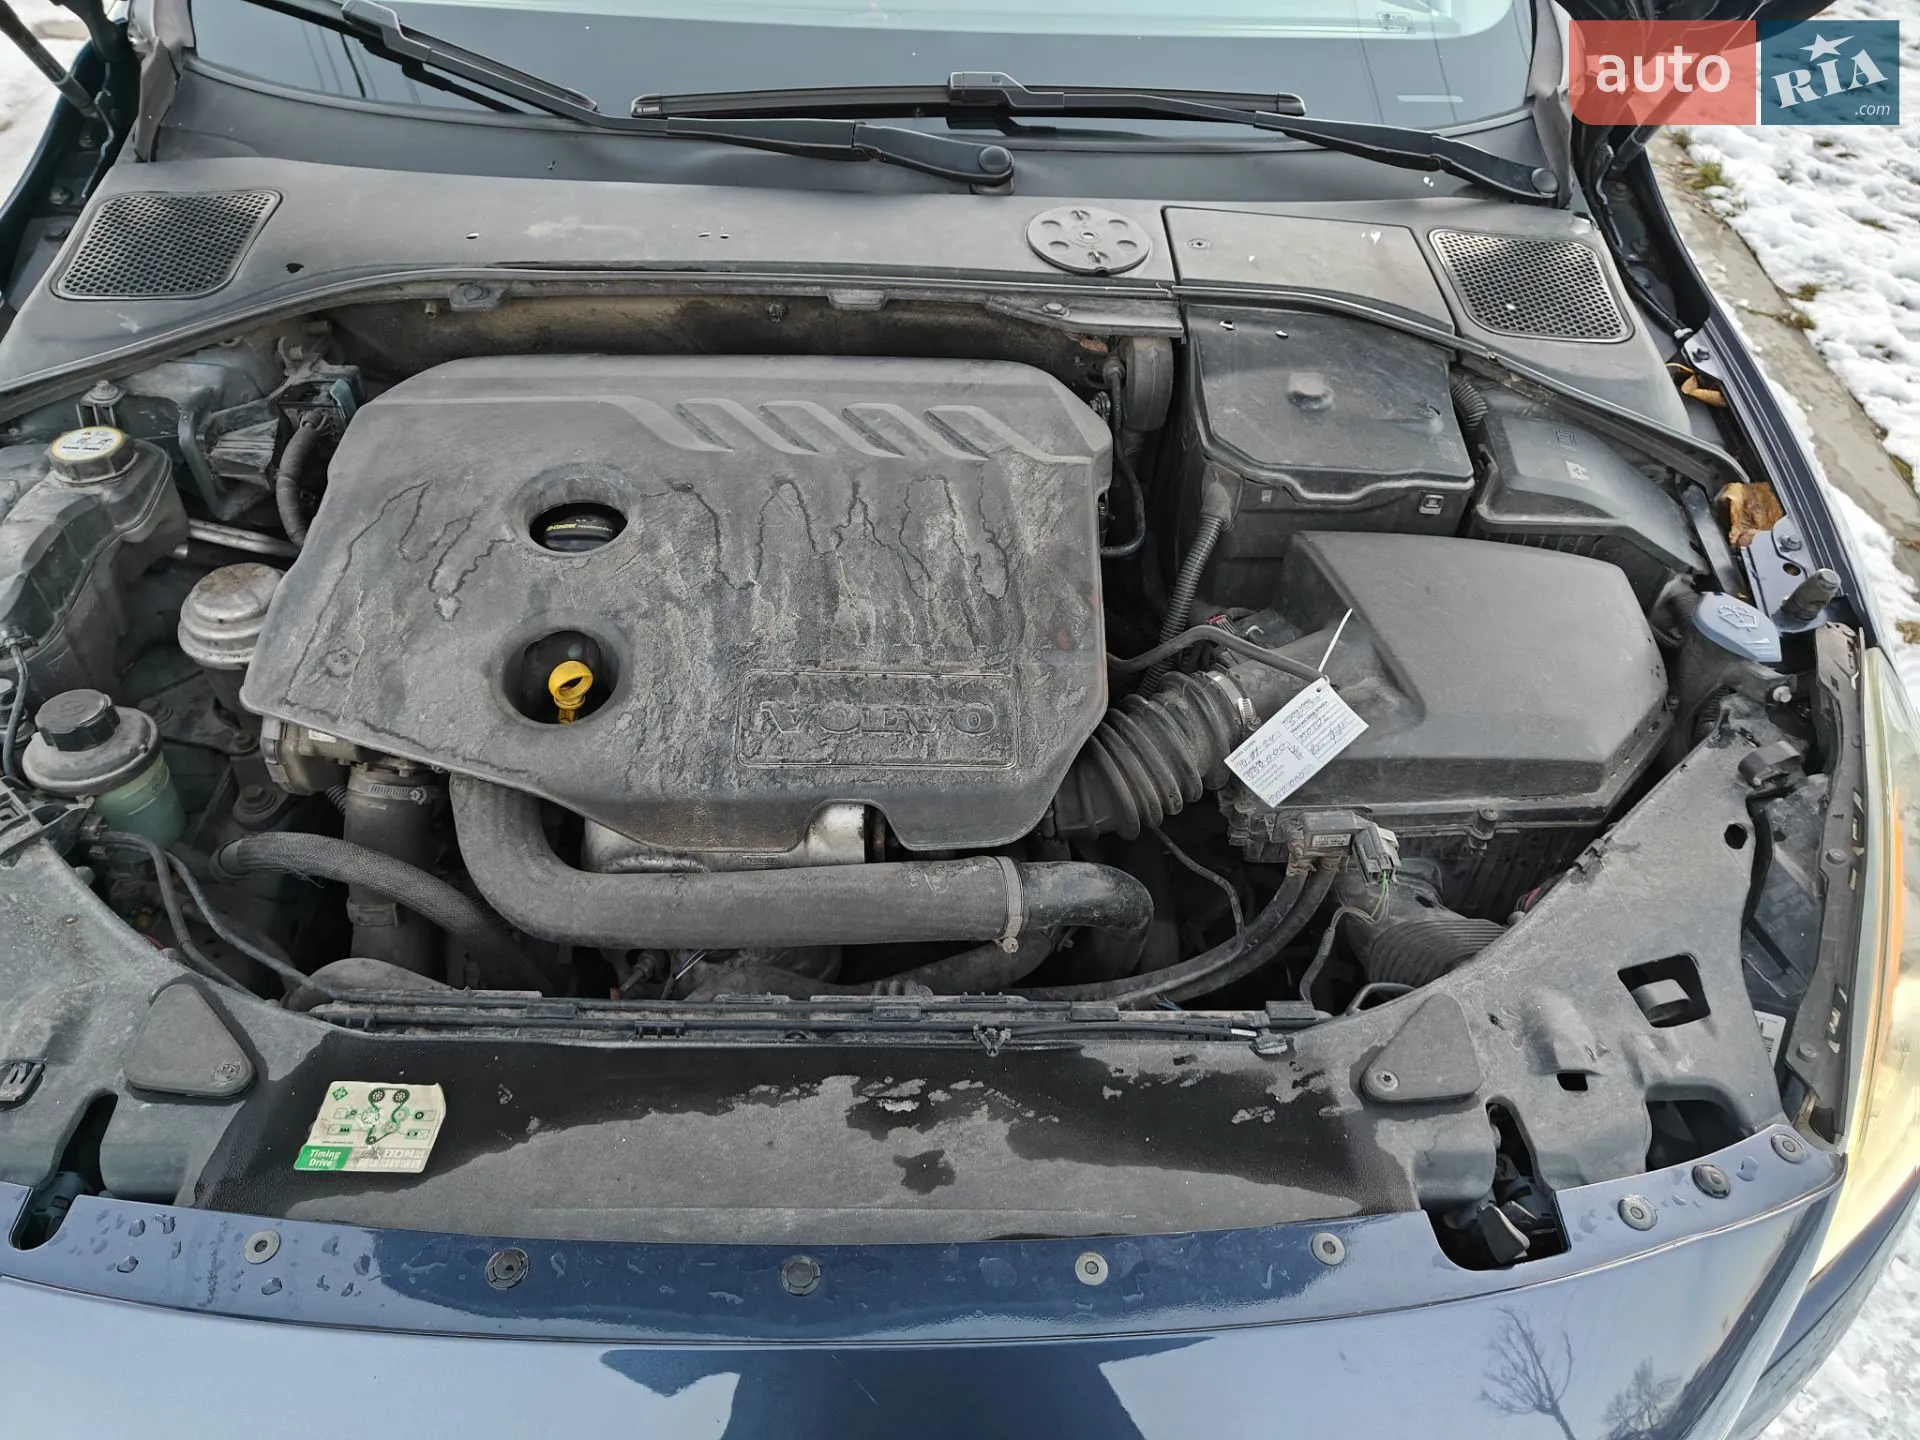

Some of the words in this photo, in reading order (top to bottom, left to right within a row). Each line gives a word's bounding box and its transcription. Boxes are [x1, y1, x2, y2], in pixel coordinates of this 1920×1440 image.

[761, 701, 996, 734] VOLVO
[309, 1149, 341, 1161] Timing
[308, 1158, 334, 1168] Drive
